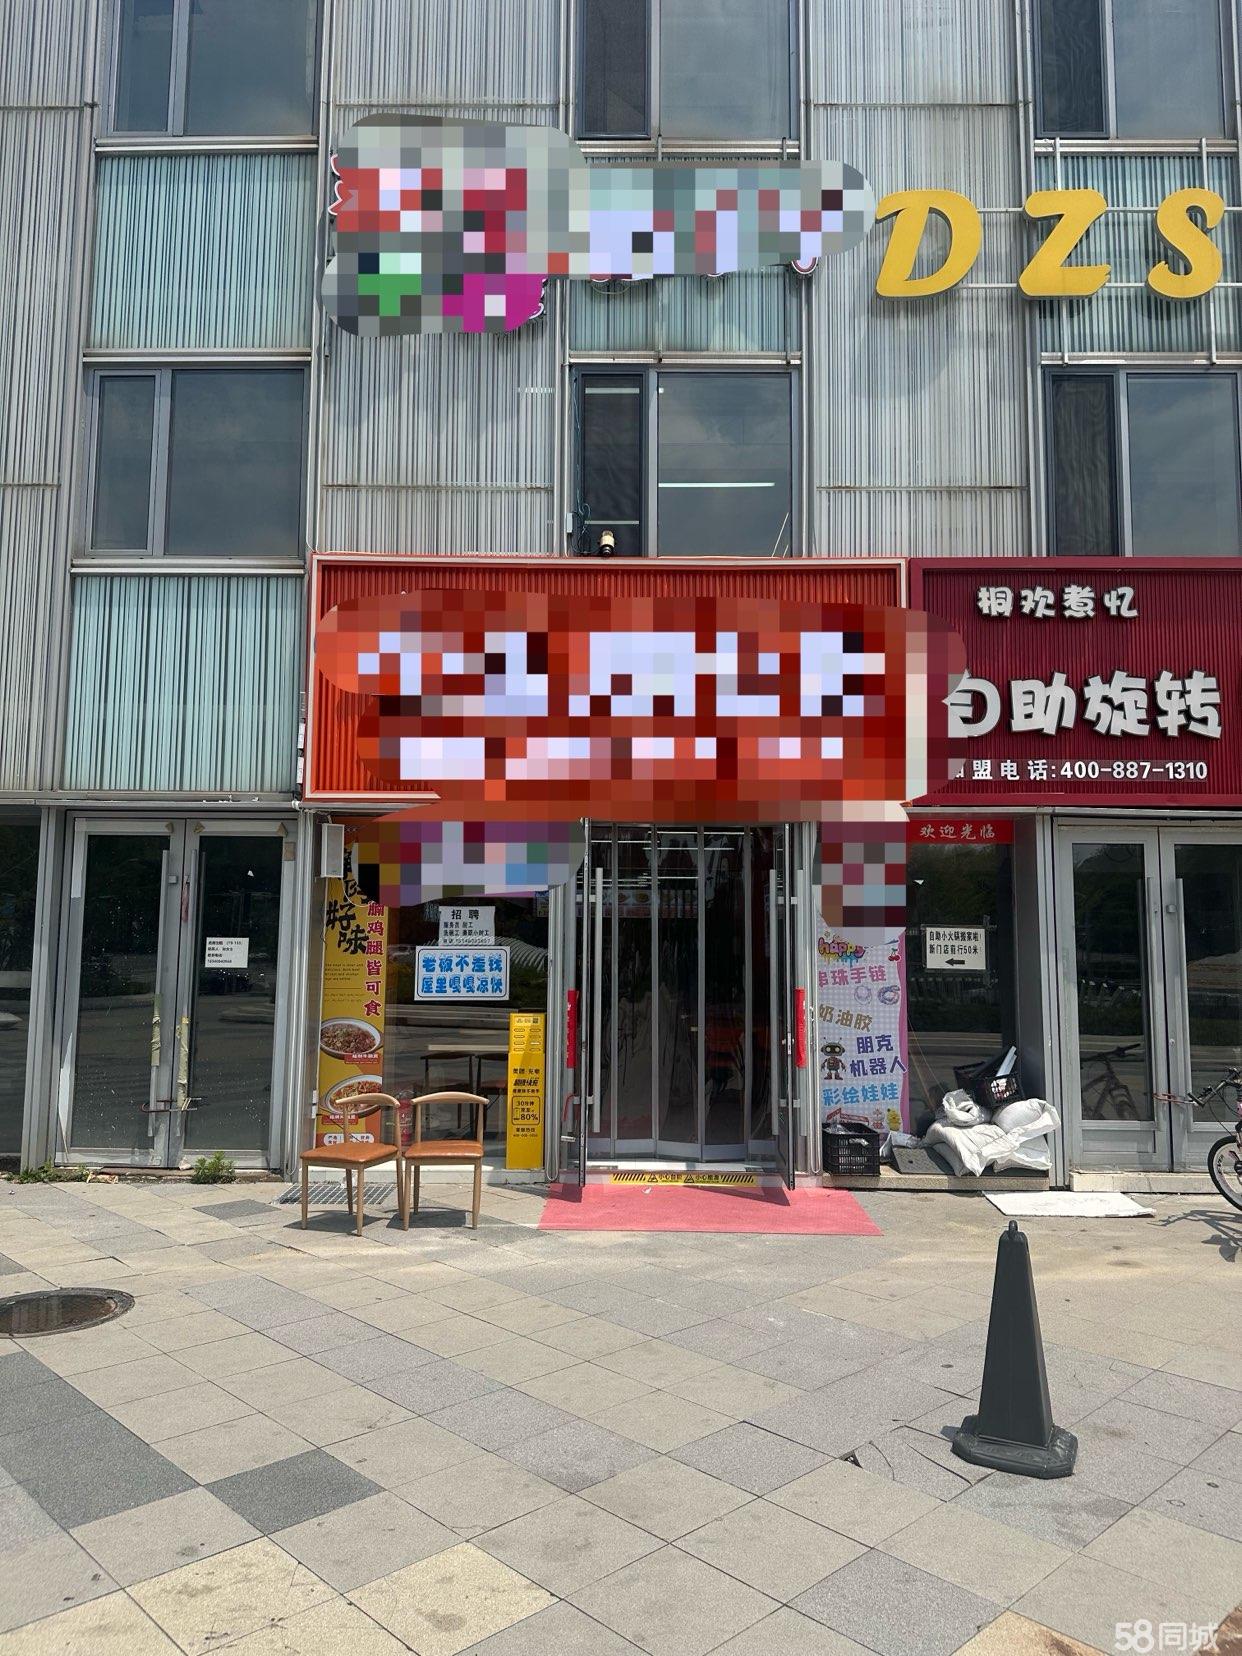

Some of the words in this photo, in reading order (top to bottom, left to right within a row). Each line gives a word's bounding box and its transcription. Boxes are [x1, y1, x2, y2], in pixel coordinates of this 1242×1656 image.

[976, 584, 1139, 619] 桐欢煮忆
[954, 759, 1208, 781] 盟电话:400-887-1310
[919, 823, 996, 840] 欢迎光临
[818, 1003, 873, 1033] 奶油胶
[856, 1034, 894, 1054] 朋克
[849, 1055, 908, 1078] 机器人
[822, 1082, 900, 1107] 彩绘娃娃
